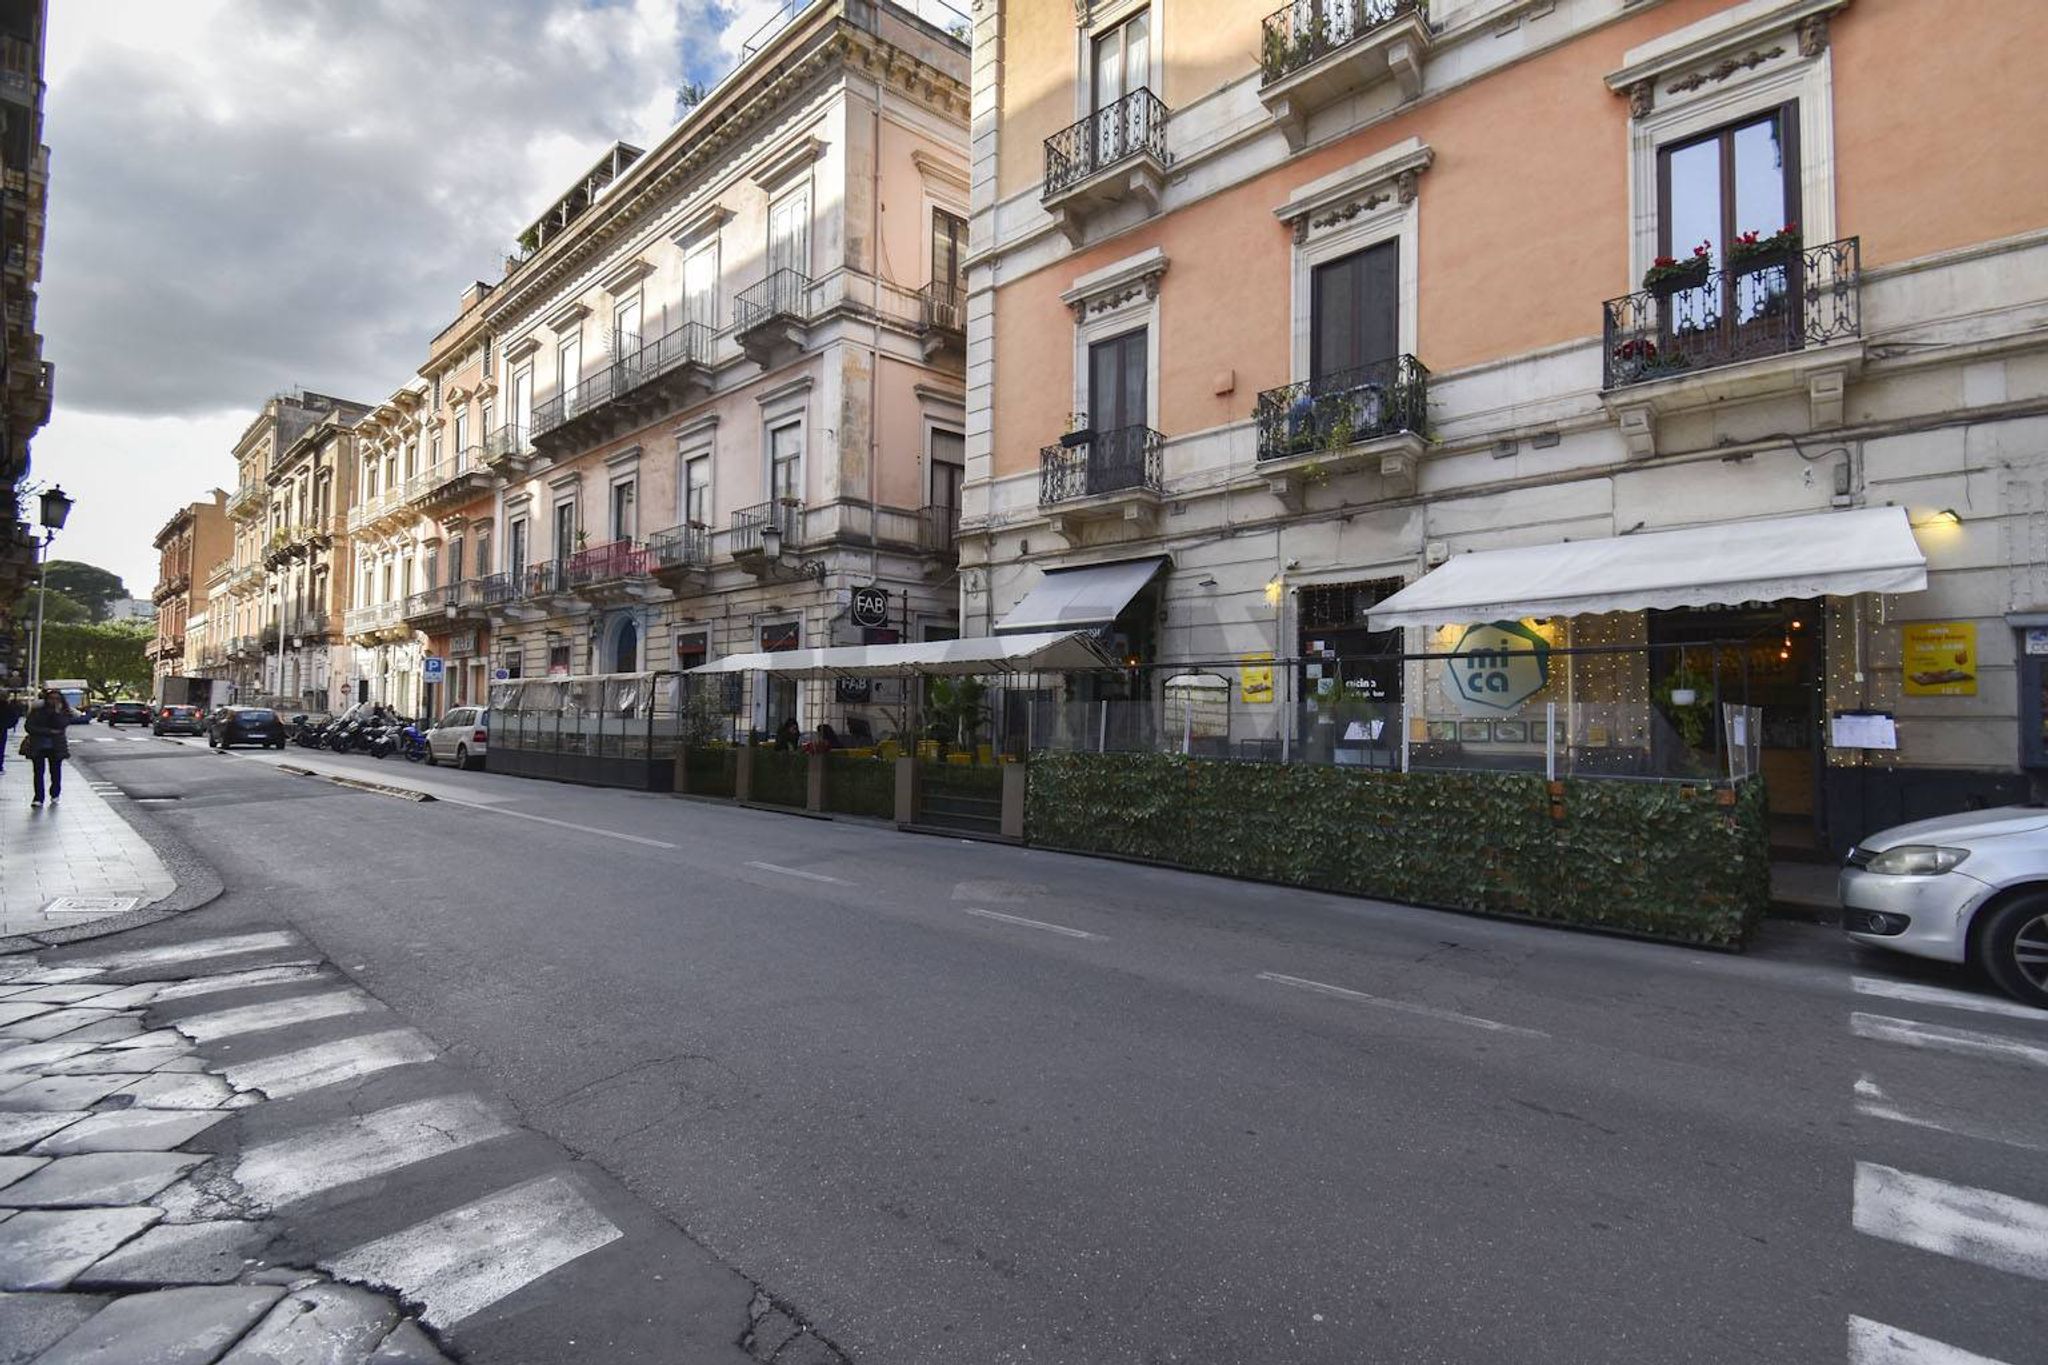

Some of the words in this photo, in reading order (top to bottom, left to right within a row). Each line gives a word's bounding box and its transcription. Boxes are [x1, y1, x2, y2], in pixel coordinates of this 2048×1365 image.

[857, 596, 884, 613] FAB
[428, 660, 439, 671] P
[1467, 671, 1509, 693] ca
